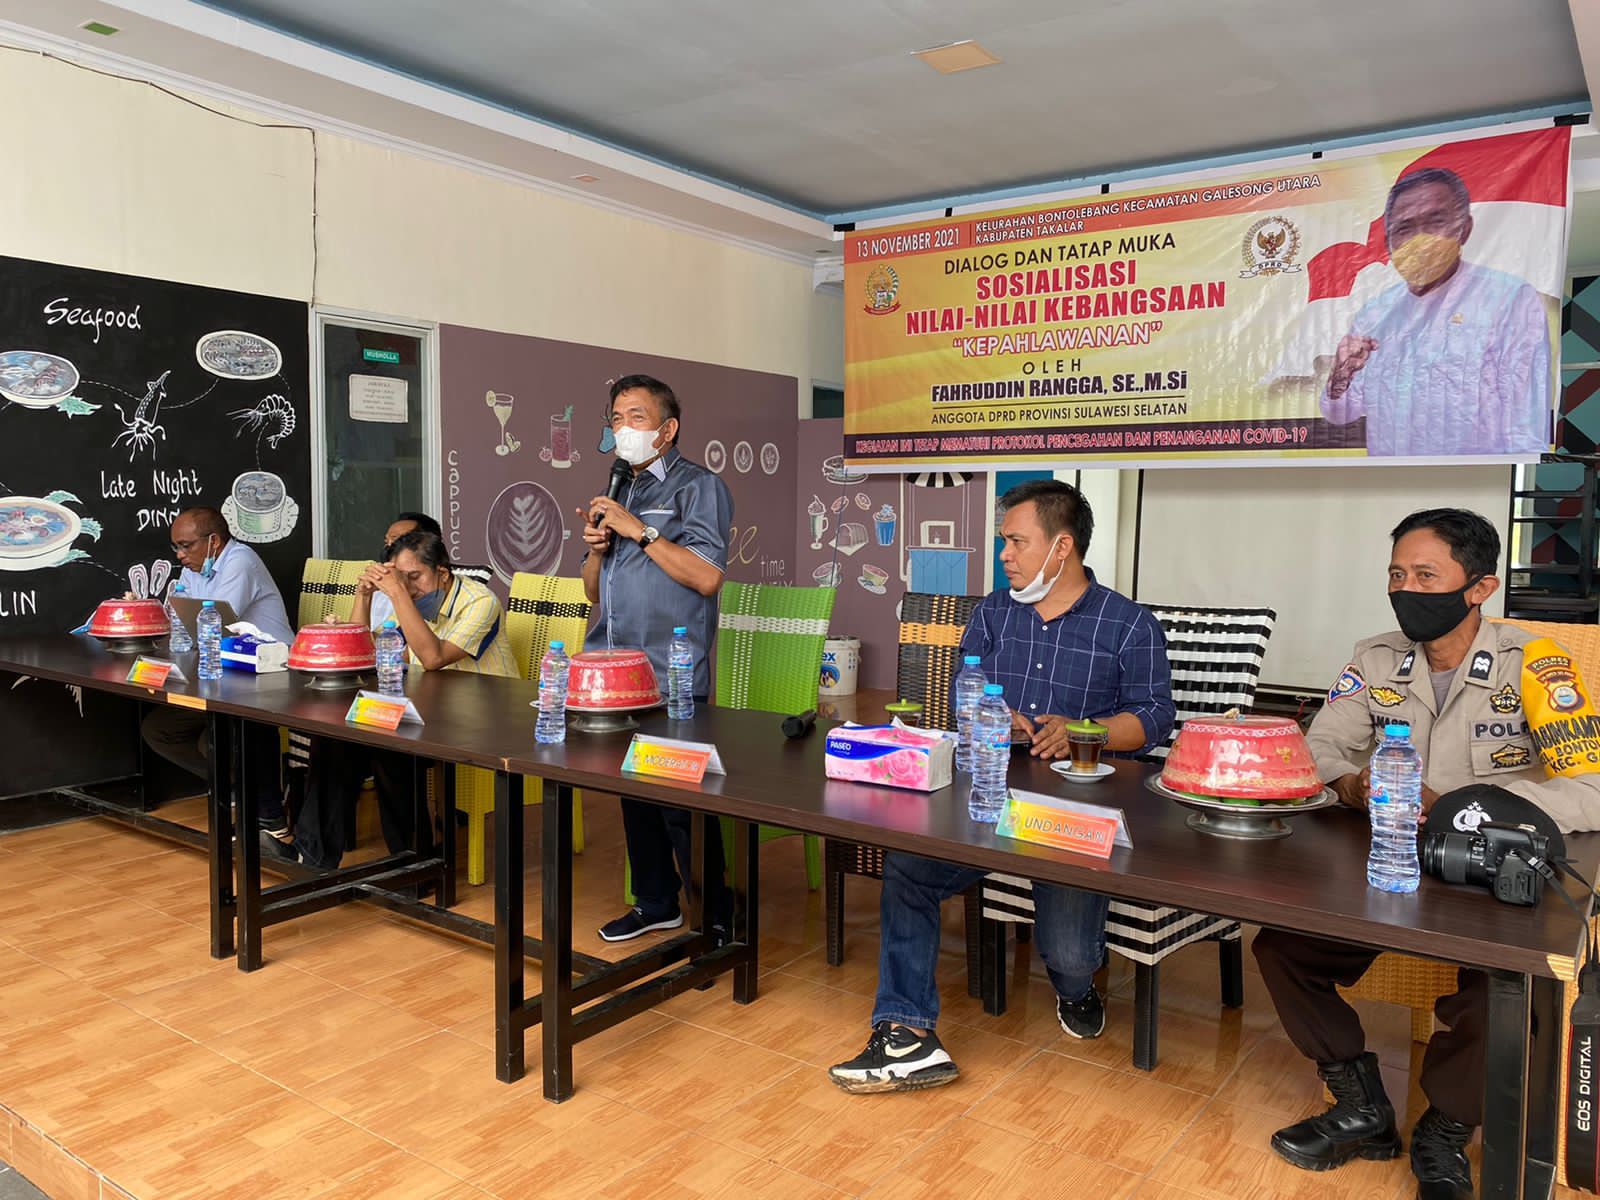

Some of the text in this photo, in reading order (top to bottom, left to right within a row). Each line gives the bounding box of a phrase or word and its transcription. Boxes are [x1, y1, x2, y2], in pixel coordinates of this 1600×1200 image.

[975, 175, 1321, 232] KELURAHAN BONTOLEBANG KECAMATAN GALESONG UTARA
[857, 228, 960, 257] 13 NOVEMBER 2021
[975, 221, 1084, 245] KABUPATEN TAKALAR
[944, 232, 1176, 275] DIALOG DAN TATAP MUKA
[976, 259, 1137, 301] SOSIALISASI
[43, 297, 141, 344] Seafood
[905, 281, 1226, 336] NILAI-NILAI KEBANGSAAN
[931, 380, 1025, 402] FAHRUDDIN
[1029, 375, 1108, 397] RANGGA,
[931, 402, 1188, 425] ANGGOTA DPRD PROVINSI SULAWESI SELATAN
[992, 434, 1045, 450] PROTOKOL
[1046, 431, 1123, 450] PENCEGAHAN
[1124, 431, 1151, 447] DAN
[1153, 429, 1241, 446] PENANGANAN
[1243, 427, 1308, 444] COVID-19
[153, 469, 202, 503] Night
[760, 554, 785, 578] time
[830, 741, 852, 751] PASEO
[1024, 815, 1104, 843] UNDANGAN
[1577, 1036, 1592, 1132] EOS DIGITAL
